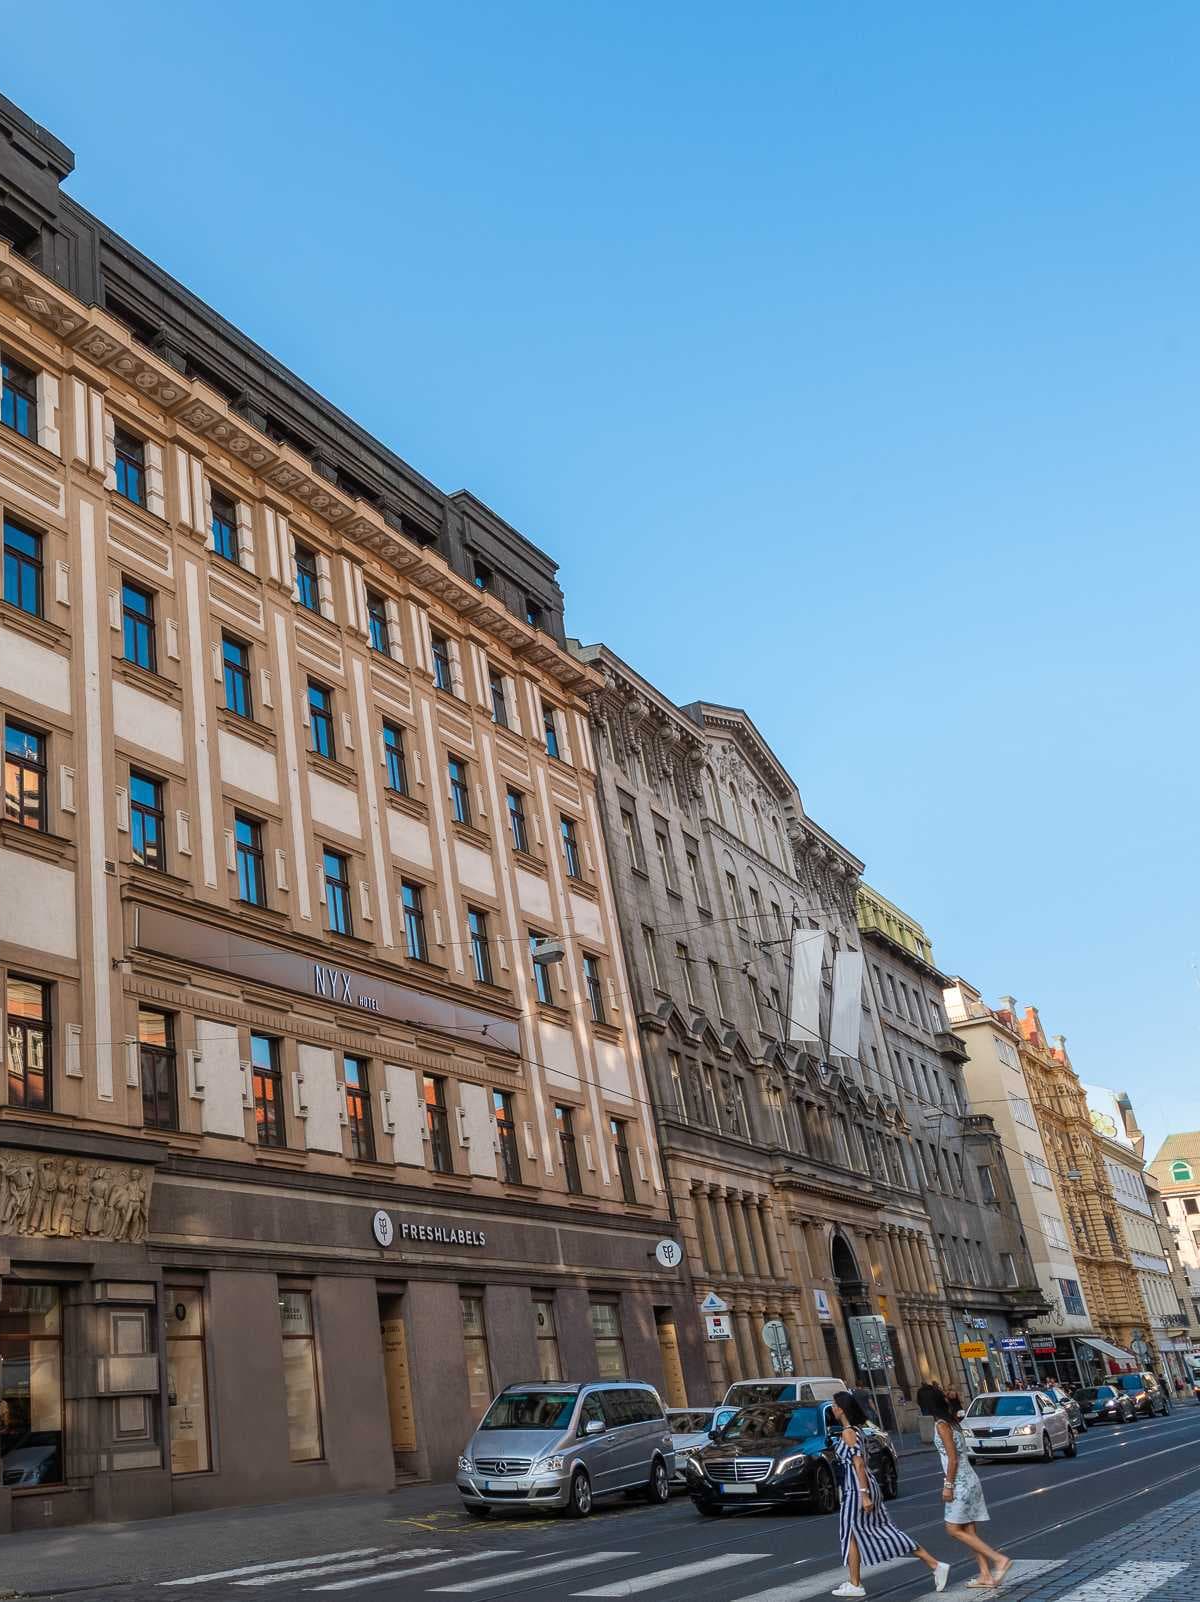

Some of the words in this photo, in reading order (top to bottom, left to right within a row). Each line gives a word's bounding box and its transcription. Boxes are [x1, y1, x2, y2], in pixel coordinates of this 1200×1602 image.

[314, 965, 353, 1003] NYX
[359, 995, 380, 1011] HOTEL
[401, 1223, 486, 1246] FRESHLABELS
